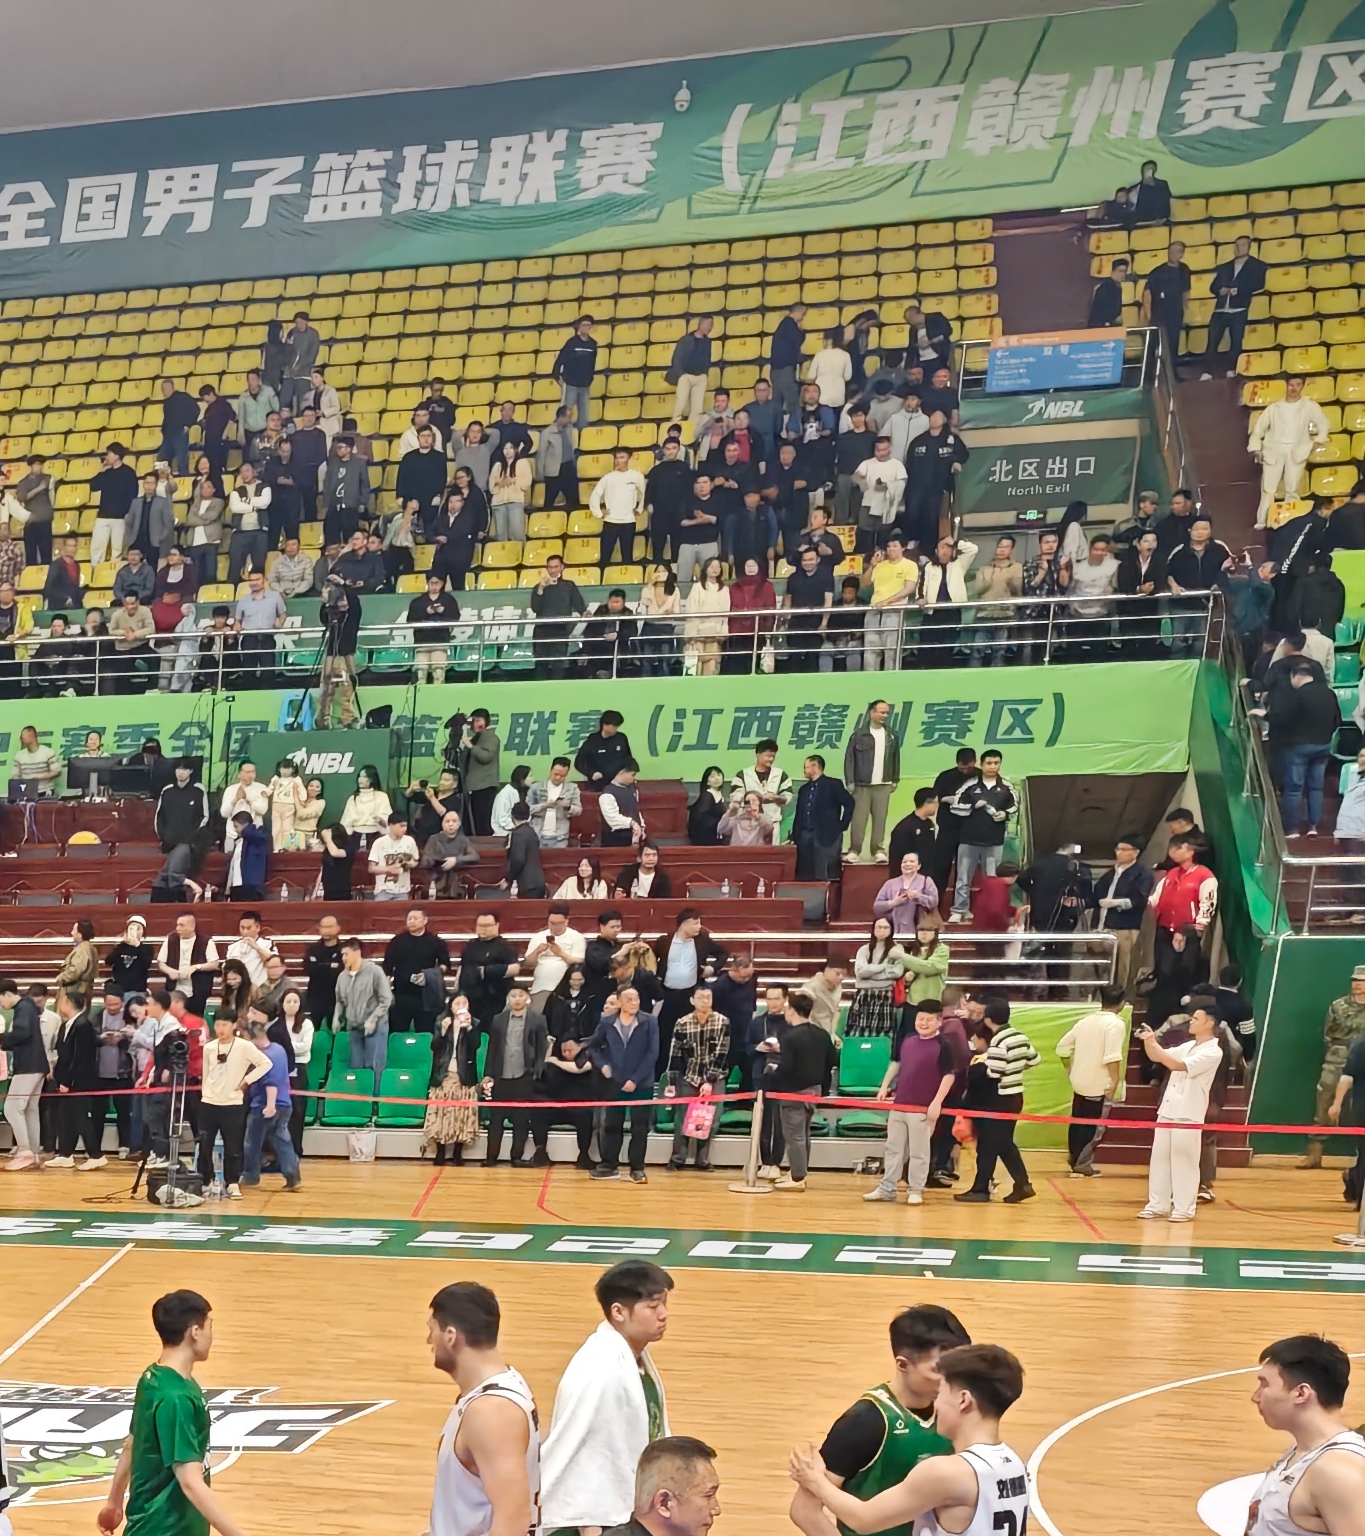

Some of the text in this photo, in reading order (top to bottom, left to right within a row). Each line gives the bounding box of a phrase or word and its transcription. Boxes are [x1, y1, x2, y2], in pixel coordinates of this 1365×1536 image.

[1043, 399, 1086, 419] NBL
[988, 455, 1097, 484] 北区出口
[1007, 484, 1043, 497] North
[305, 751, 356, 775] NBL
